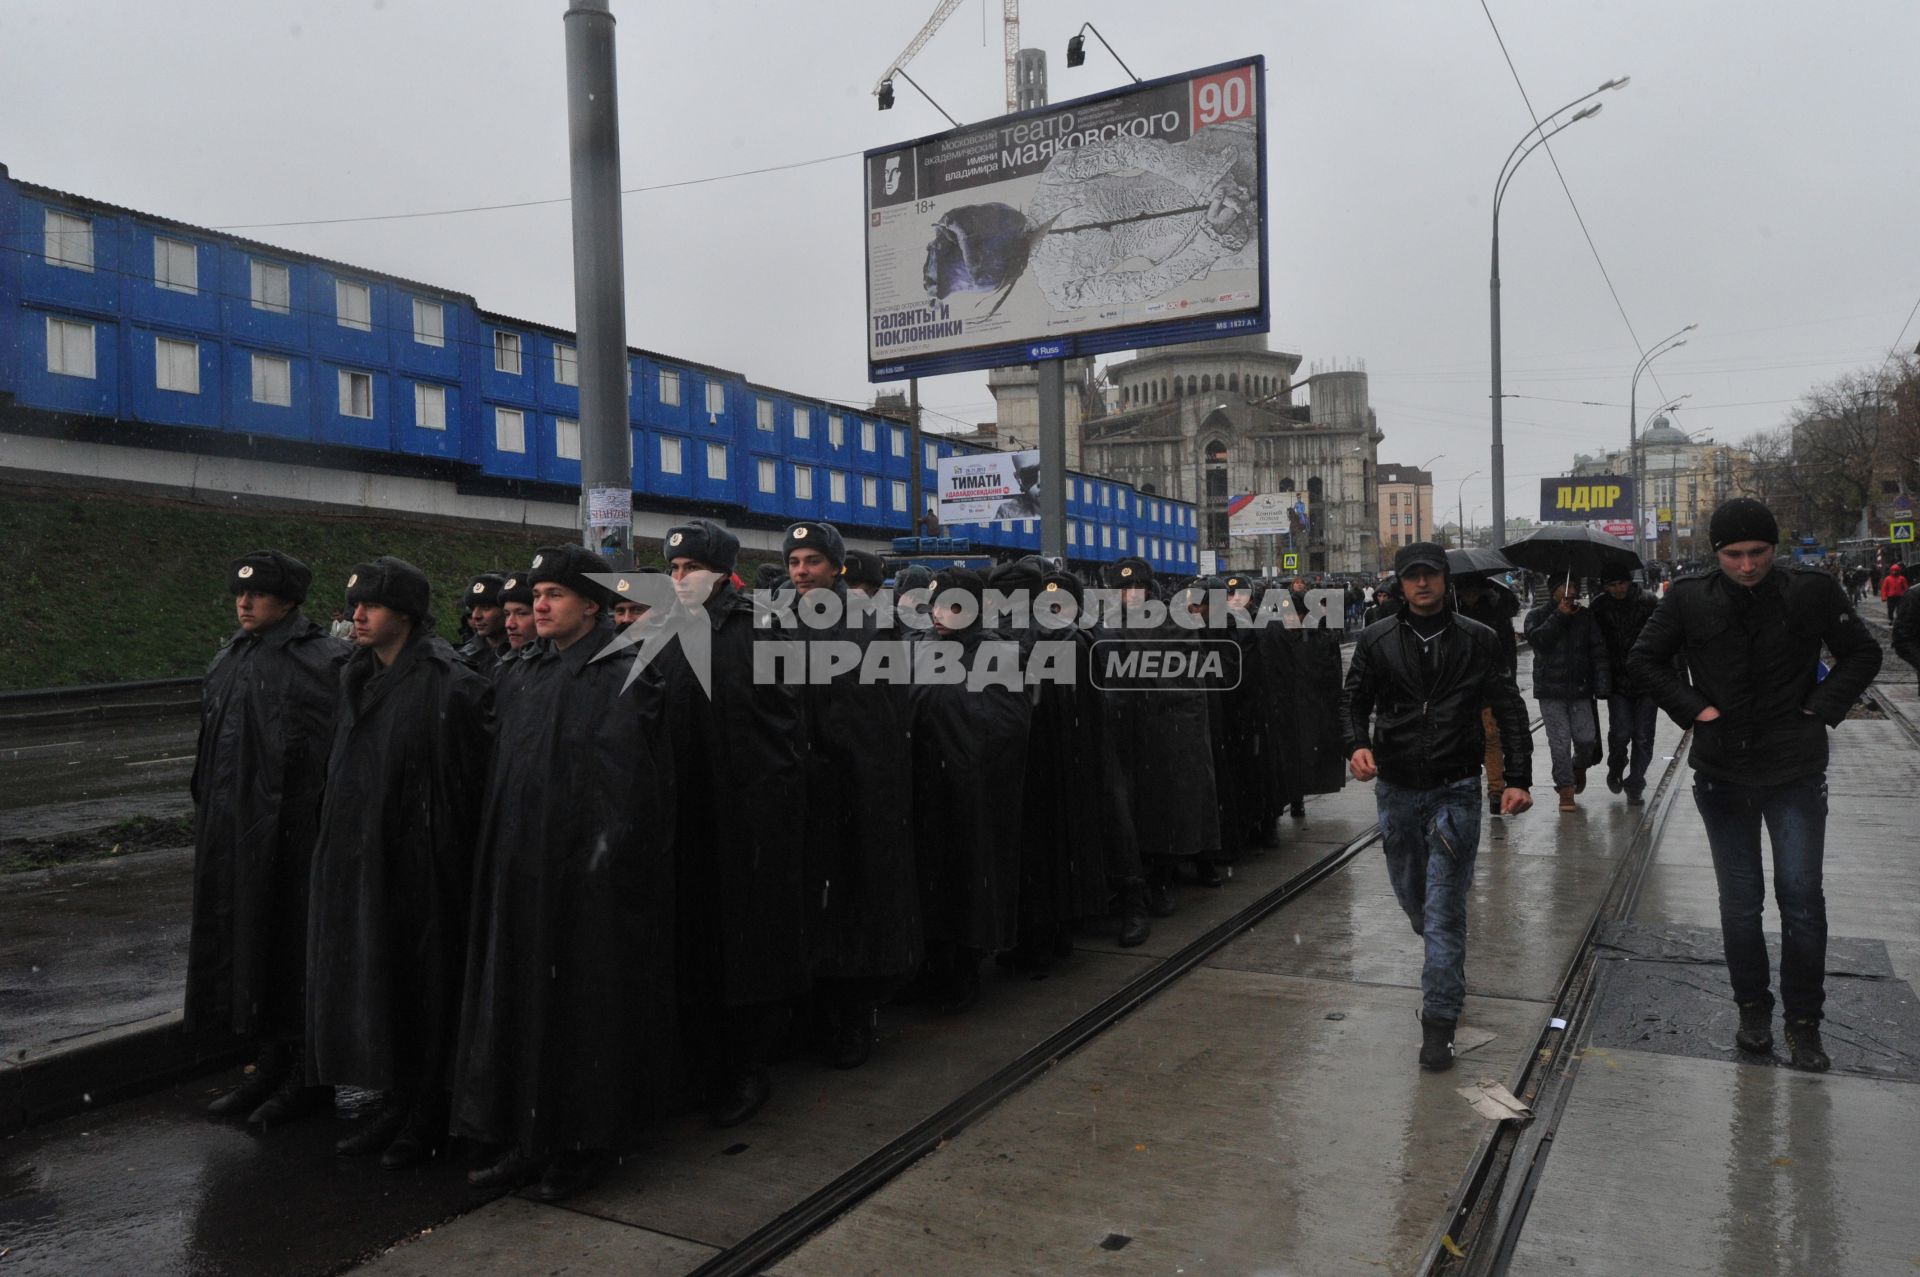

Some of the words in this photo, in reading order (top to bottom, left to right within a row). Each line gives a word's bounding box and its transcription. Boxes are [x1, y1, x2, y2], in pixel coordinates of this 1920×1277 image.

[1199, 77, 1246, 123] 90
[1001, 112, 1075, 147] театр
[924, 140, 998, 167] академический
[967, 152, 998, 166] имени
[945, 162, 999, 182] владимира
[914, 200, 936, 215] 18+
[873, 307, 936, 331] таланты
[940, 304, 950, 320] и
[875, 319, 963, 347] поклонники
[1040, 346, 1059, 355] Russ
[951, 473, 1001, 490] ТИМАТИ
[1555, 485, 1620, 512] ЛДПР
